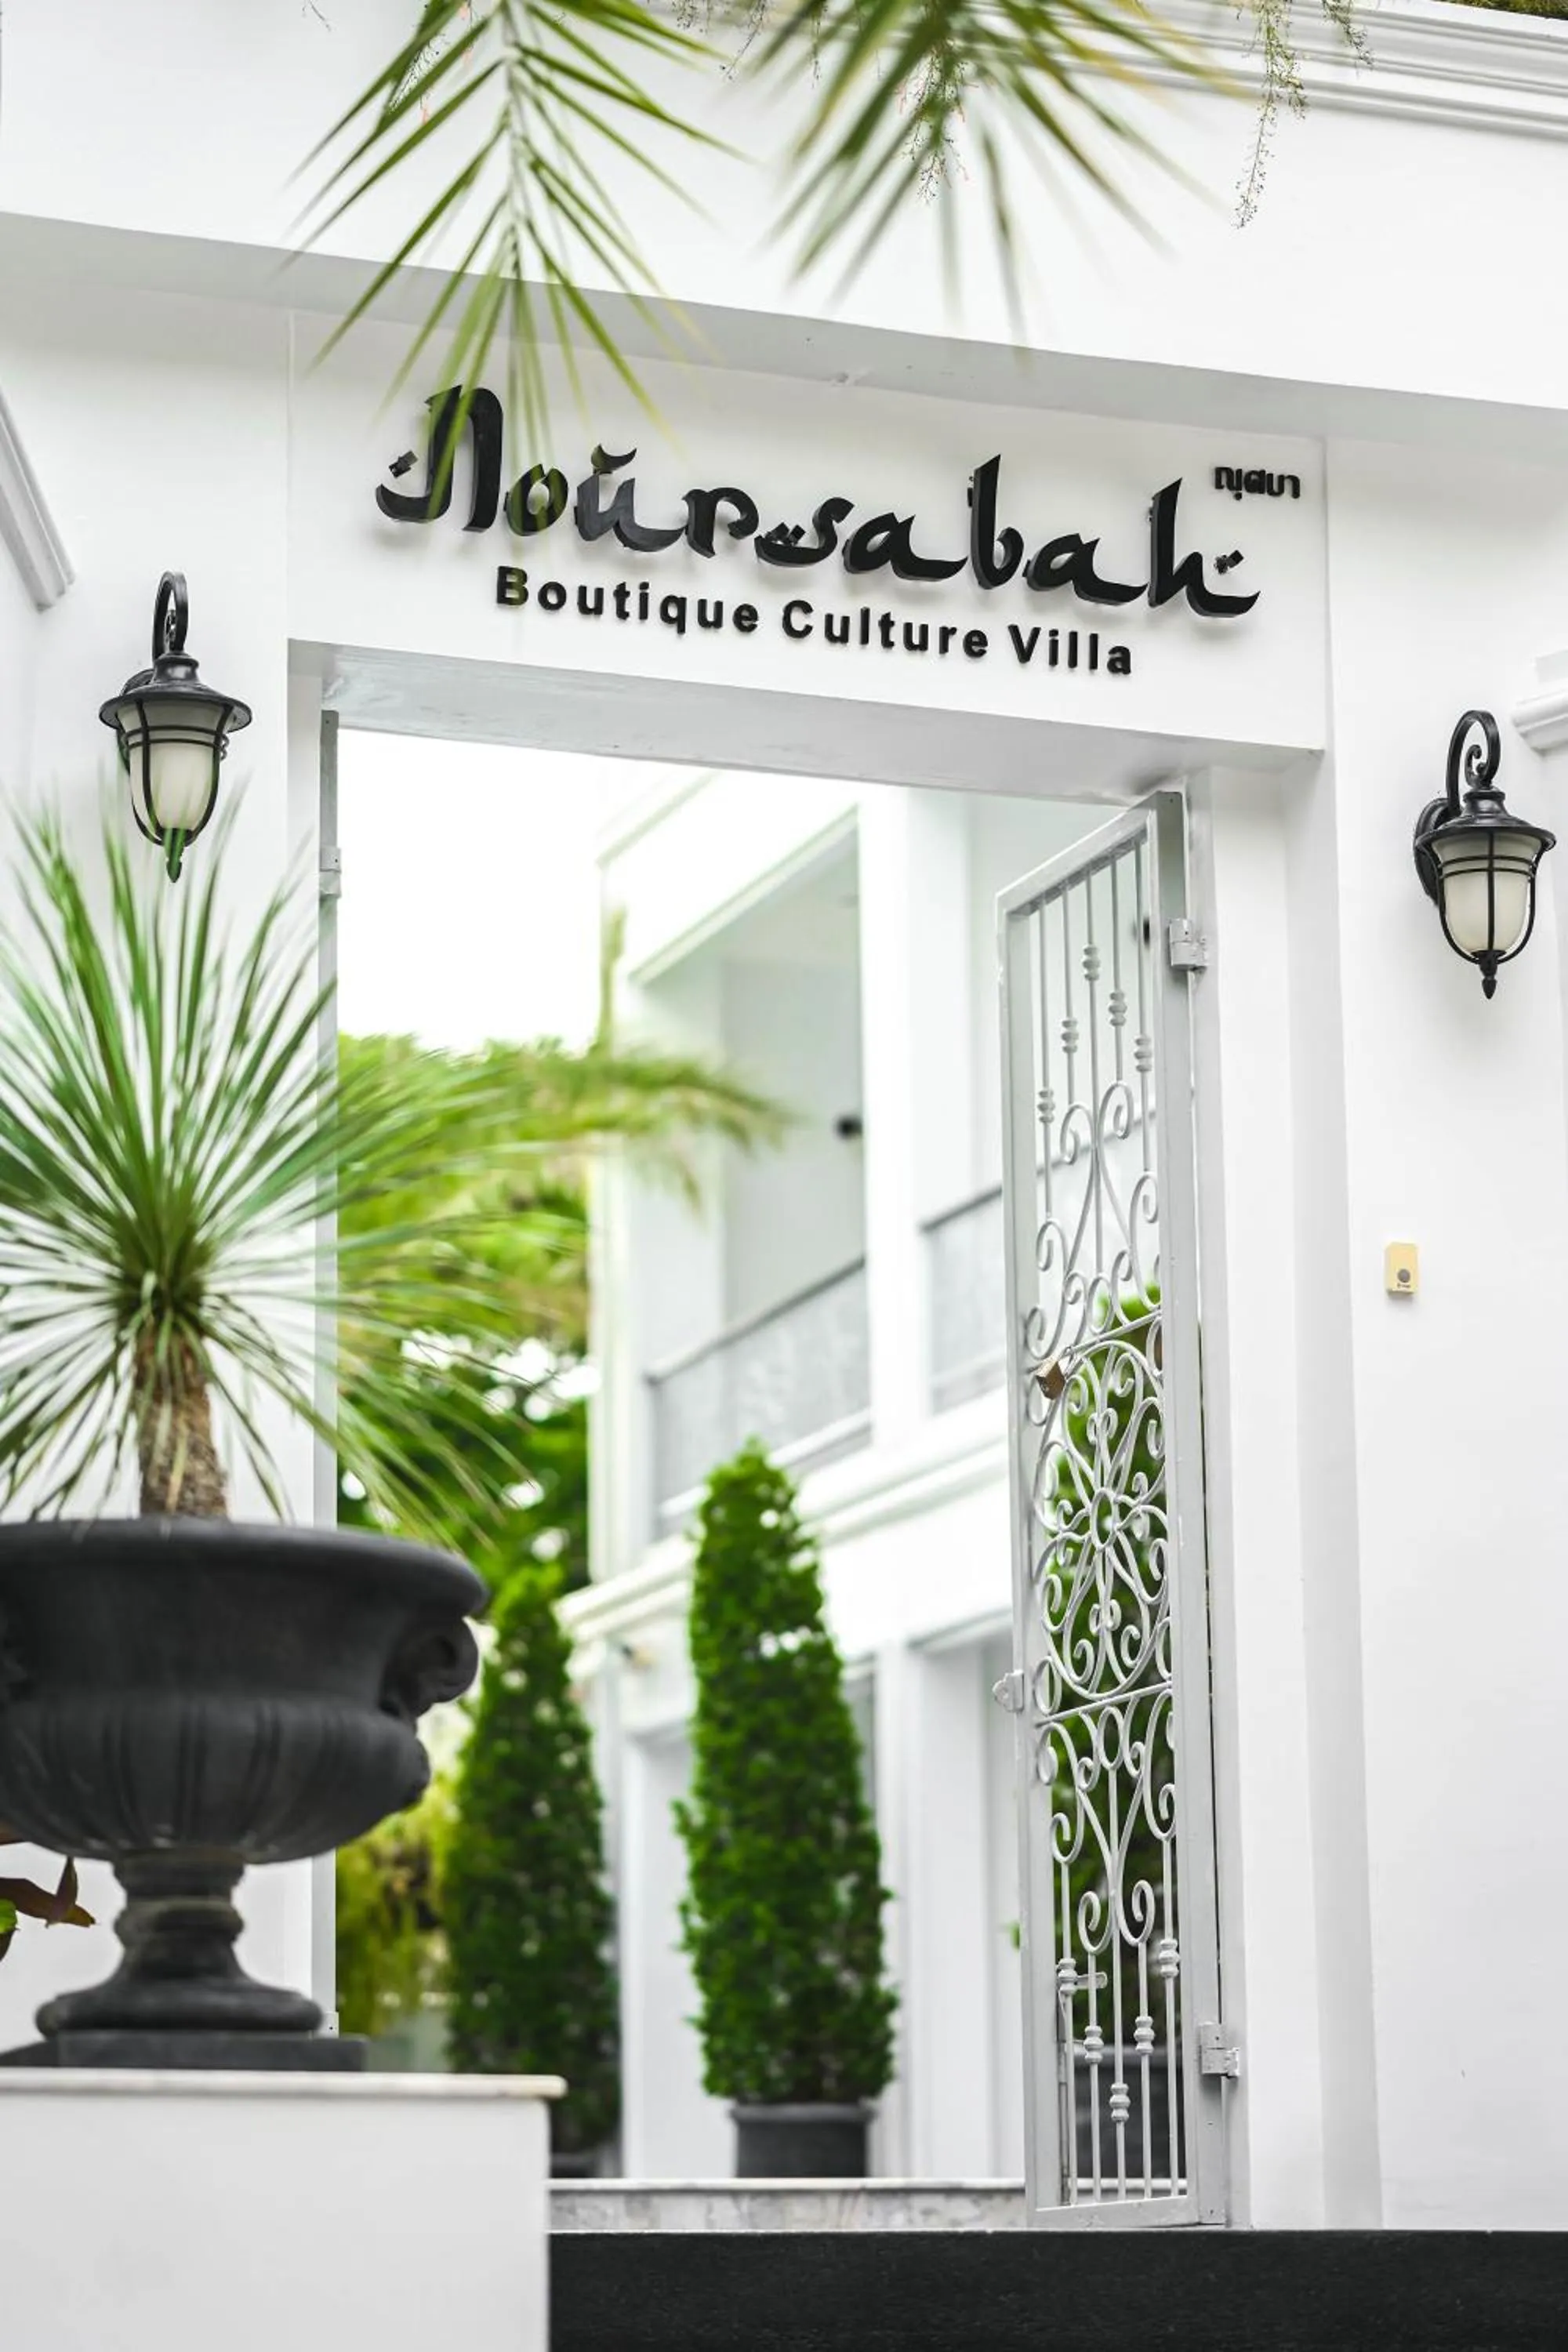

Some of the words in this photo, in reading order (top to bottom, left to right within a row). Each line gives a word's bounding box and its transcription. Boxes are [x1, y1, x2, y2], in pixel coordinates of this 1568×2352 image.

[496, 565, 759, 635] Boutique
[782, 599, 989, 659] Culture
[1007, 624, 1132, 675] Villa
